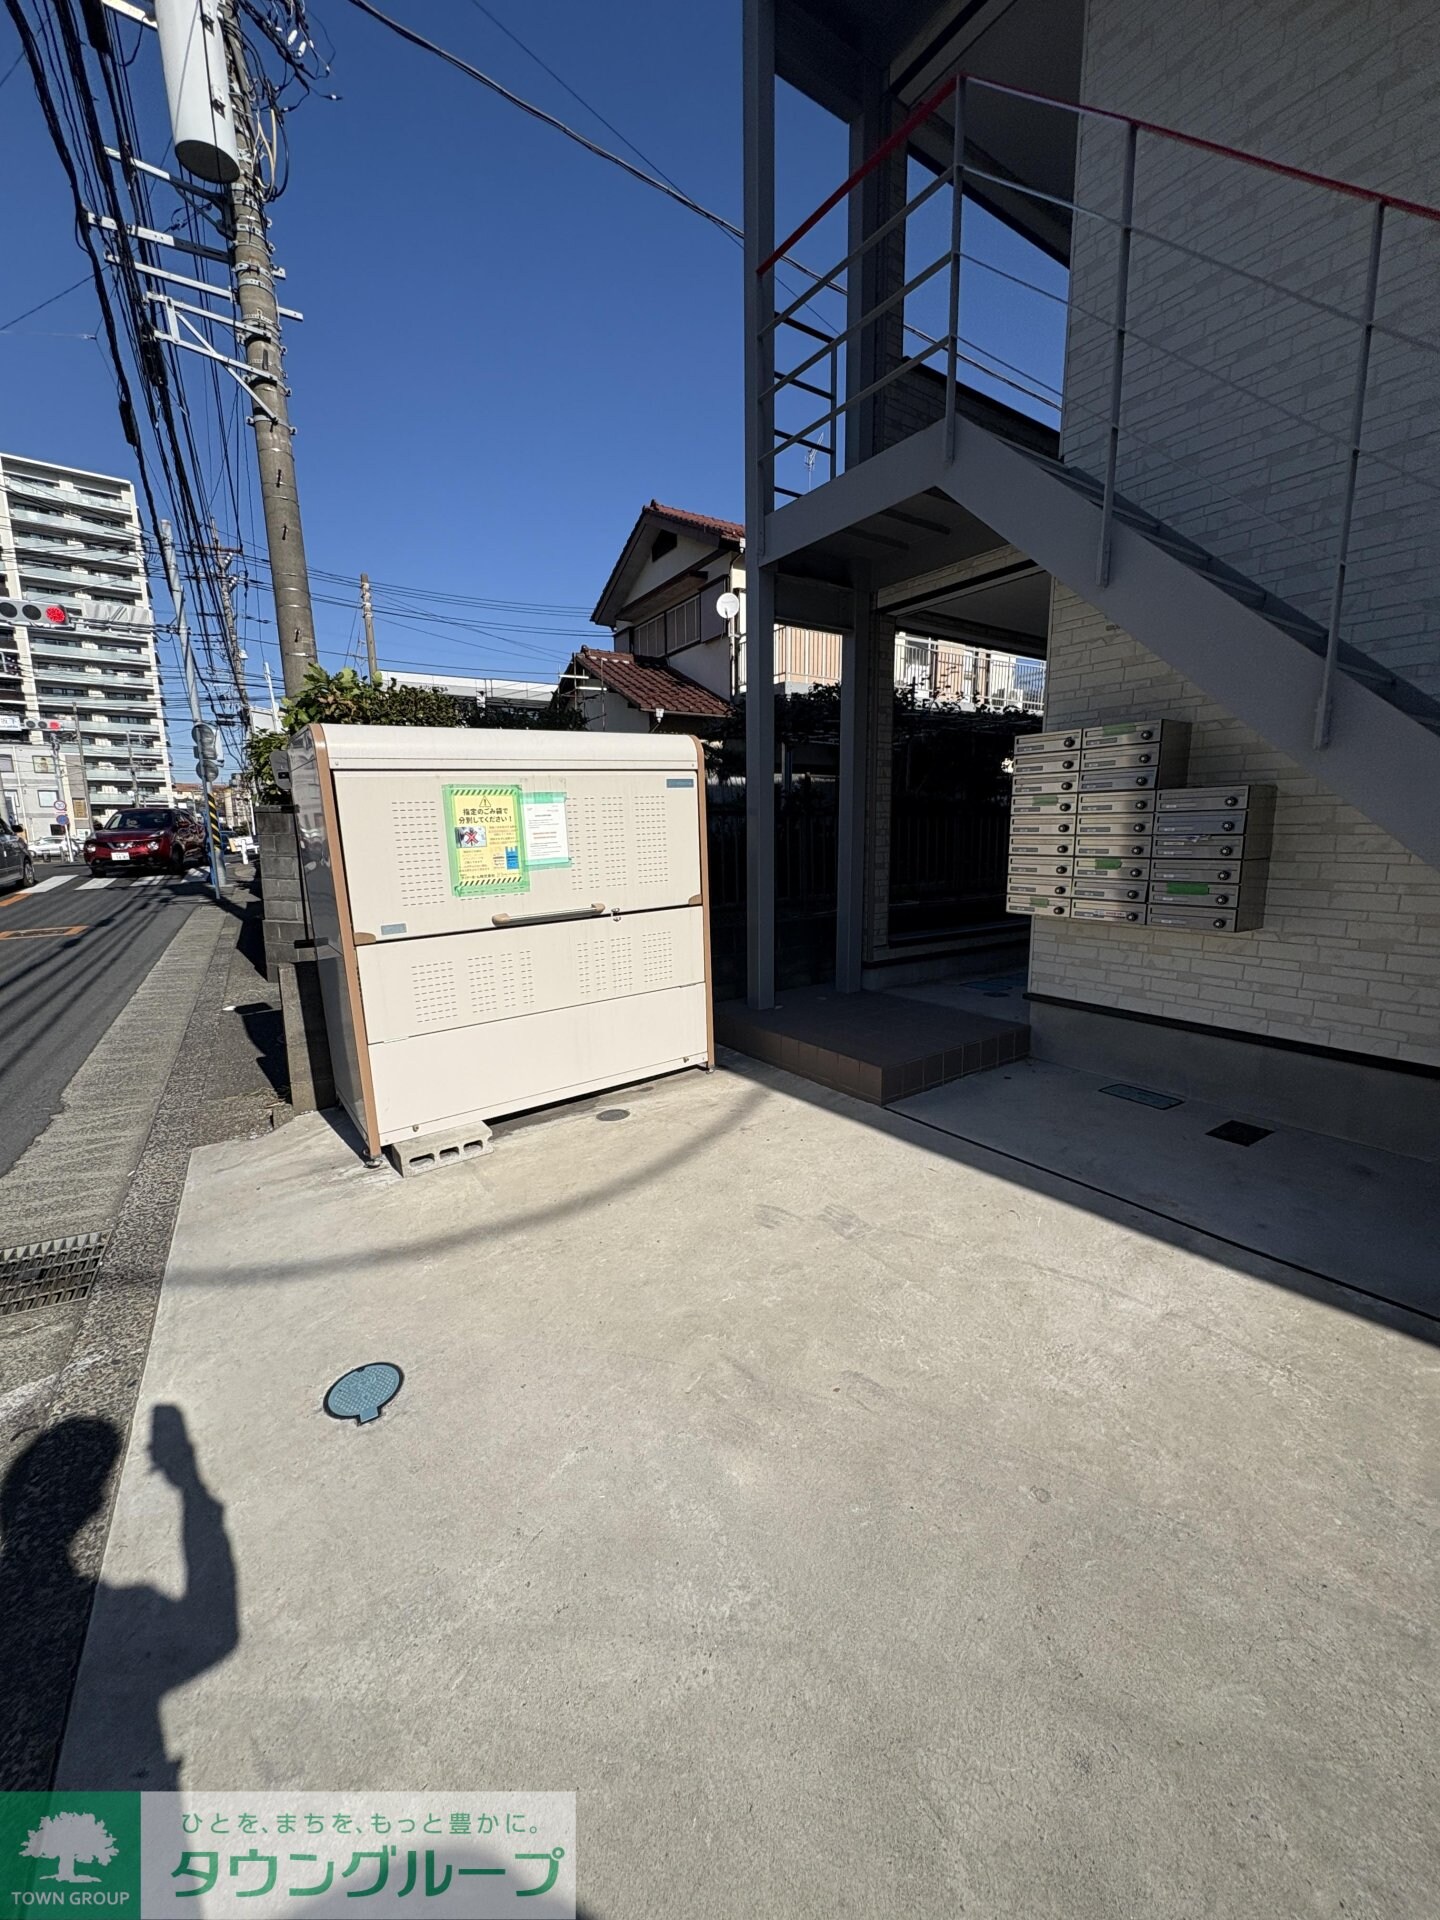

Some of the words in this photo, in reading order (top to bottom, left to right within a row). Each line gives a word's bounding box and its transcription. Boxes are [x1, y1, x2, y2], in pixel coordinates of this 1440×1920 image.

[463, 808, 508, 816] 指定のごみ袋で
